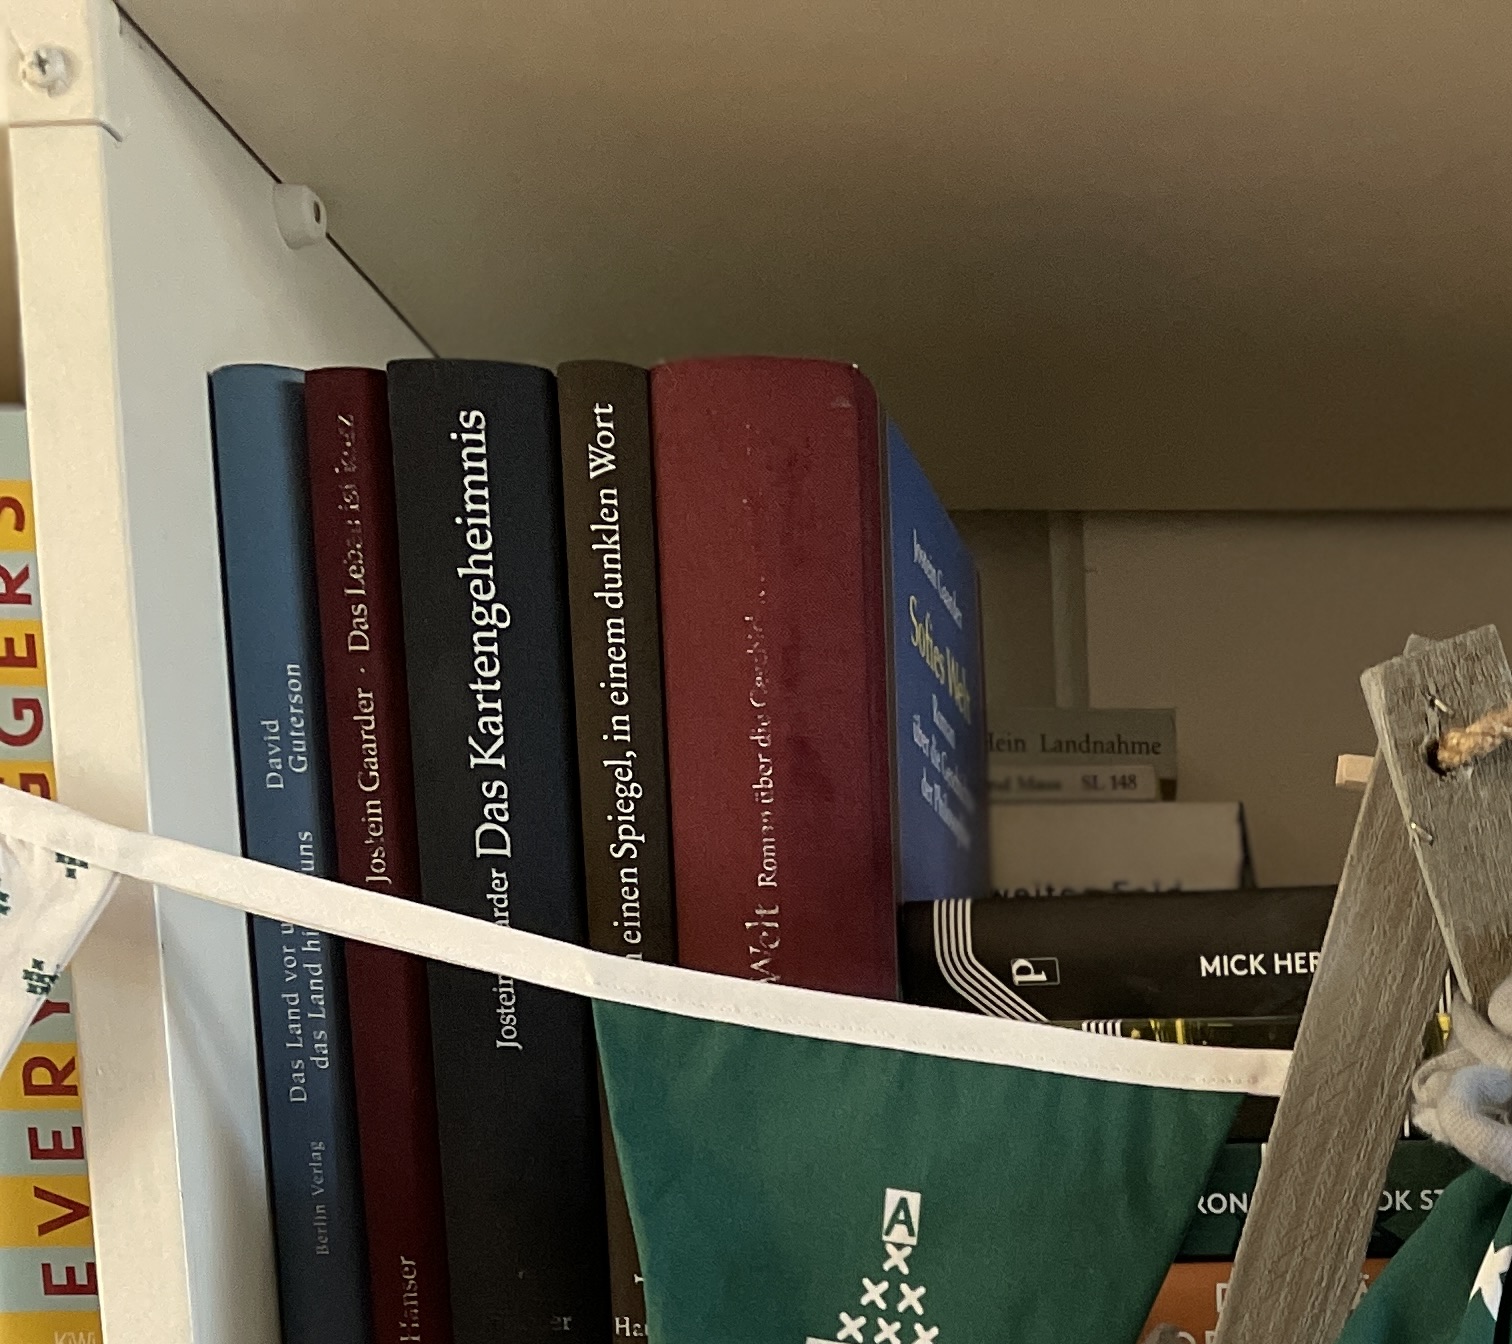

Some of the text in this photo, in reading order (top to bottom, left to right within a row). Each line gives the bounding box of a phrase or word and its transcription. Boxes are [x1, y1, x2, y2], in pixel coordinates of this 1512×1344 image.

[588, 403, 618, 480] Wort
[590, 487, 623, 610] dunklen
[449, 408, 511, 770] Kartengeheimnis
[348, 603, 370, 652] Das
[600, 616, 631, 706] einem
[286, 663, 308, 773] Guterson
[353, 687, 381, 794] Gaarder
[602, 713, 631, 743] in
[1040, 733, 1162, 755] Landnahme
[261, 719, 284, 790] David
[751, 751, 775, 806] über
[475, 780, 512, 860] Das
[603, 750, 644, 860] Spiegel,
[612, 865, 643, 945] einen
[283, 945, 297, 981] vor
[305, 963, 325, 1021] Land
[1200, 954, 1266, 977] MICK
[282, 993, 302, 1049] Land
[309, 1030, 329, 1070] das
[290, 1059, 307, 1104] Das
[311, 1140, 329, 1256] Berlin Verlag
[884, 1196, 916, 1238] A
